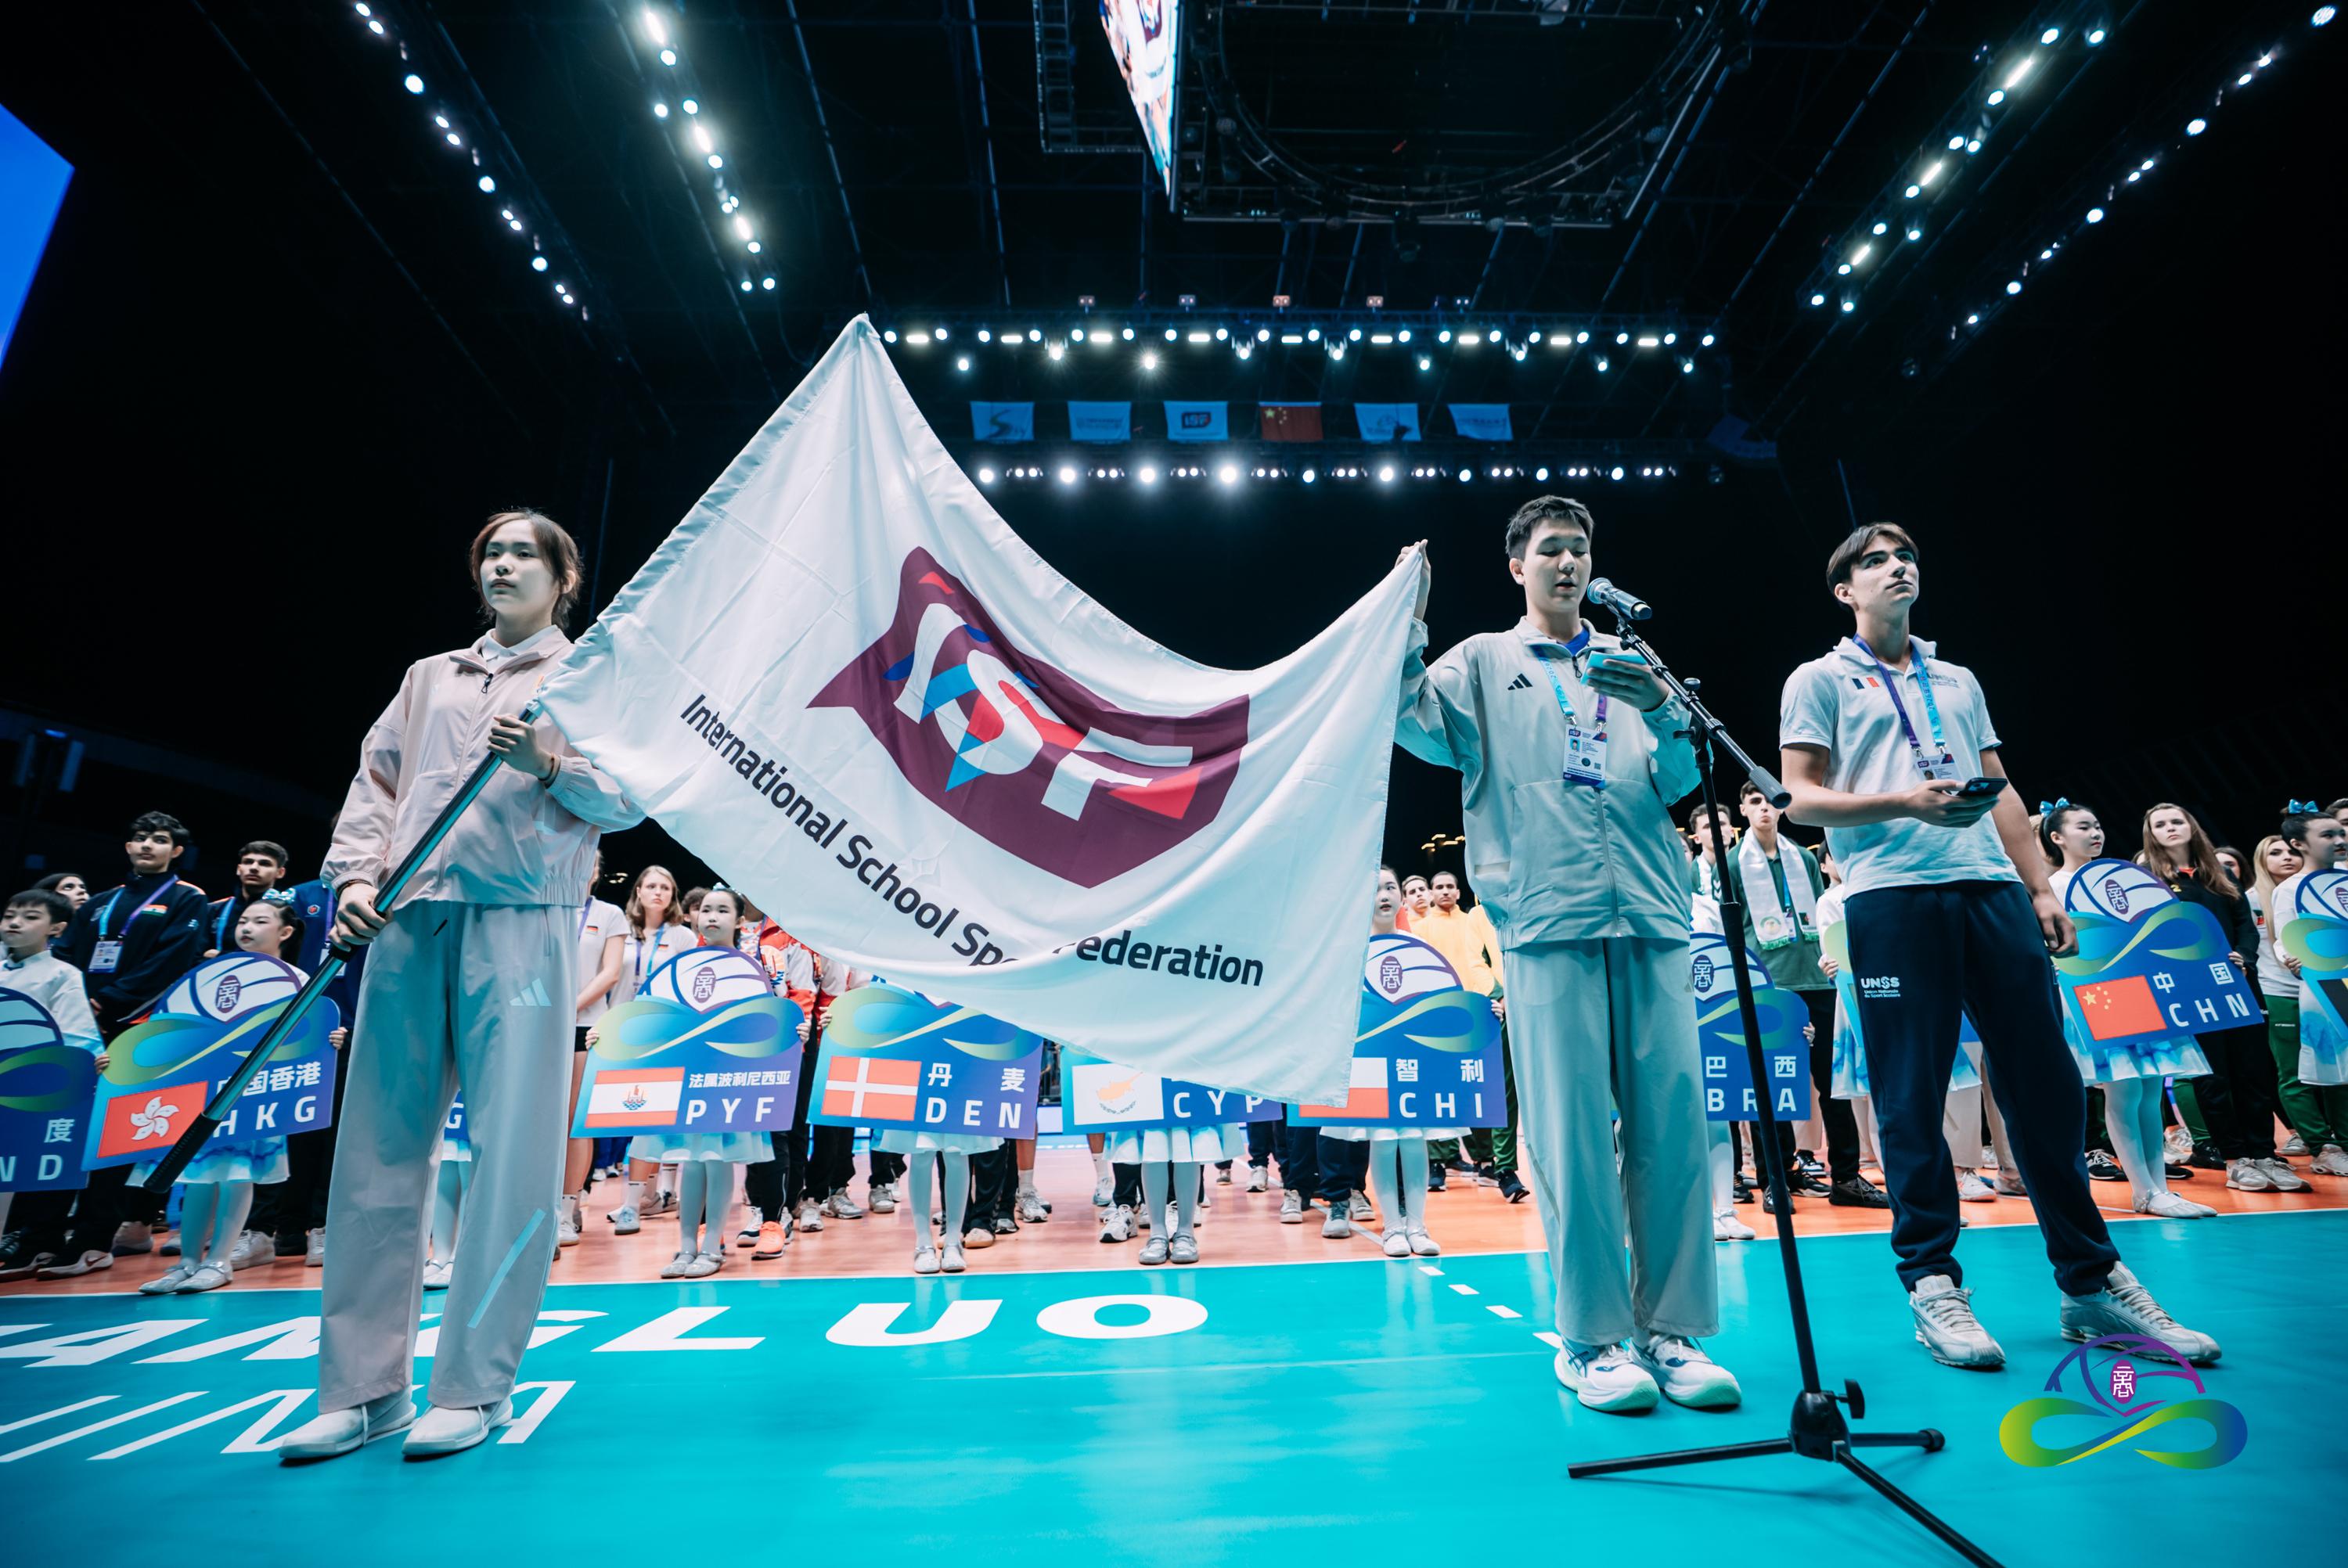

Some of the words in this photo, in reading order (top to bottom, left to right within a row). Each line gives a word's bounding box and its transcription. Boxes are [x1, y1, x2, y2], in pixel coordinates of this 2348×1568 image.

[680, 694, 848, 850] International
[836, 834, 960, 939] School
[1053, 930, 1264, 987] ederation
[1860, 976, 1900, 989] UNSS
[2153, 962, 2235, 994] 中国
[2169, 993, 2250, 1027] CHN
[689, 1070, 791, 1088] 法属波利尼西亚
[927, 1063, 1025, 1092] 丹麦
[1396, 1059, 1484, 1082] 智利
[1706, 1056, 1797, 1077] 巴西
[686, 1097, 775, 1125] PYF
[925, 1097, 1021, 1128] DEN
[1173, 1090, 1263, 1118] CYP
[1399, 1092, 1482, 1118] CHI
[1707, 1088, 1796, 1112] BRA
[213, 1095, 316, 1138] HKG
